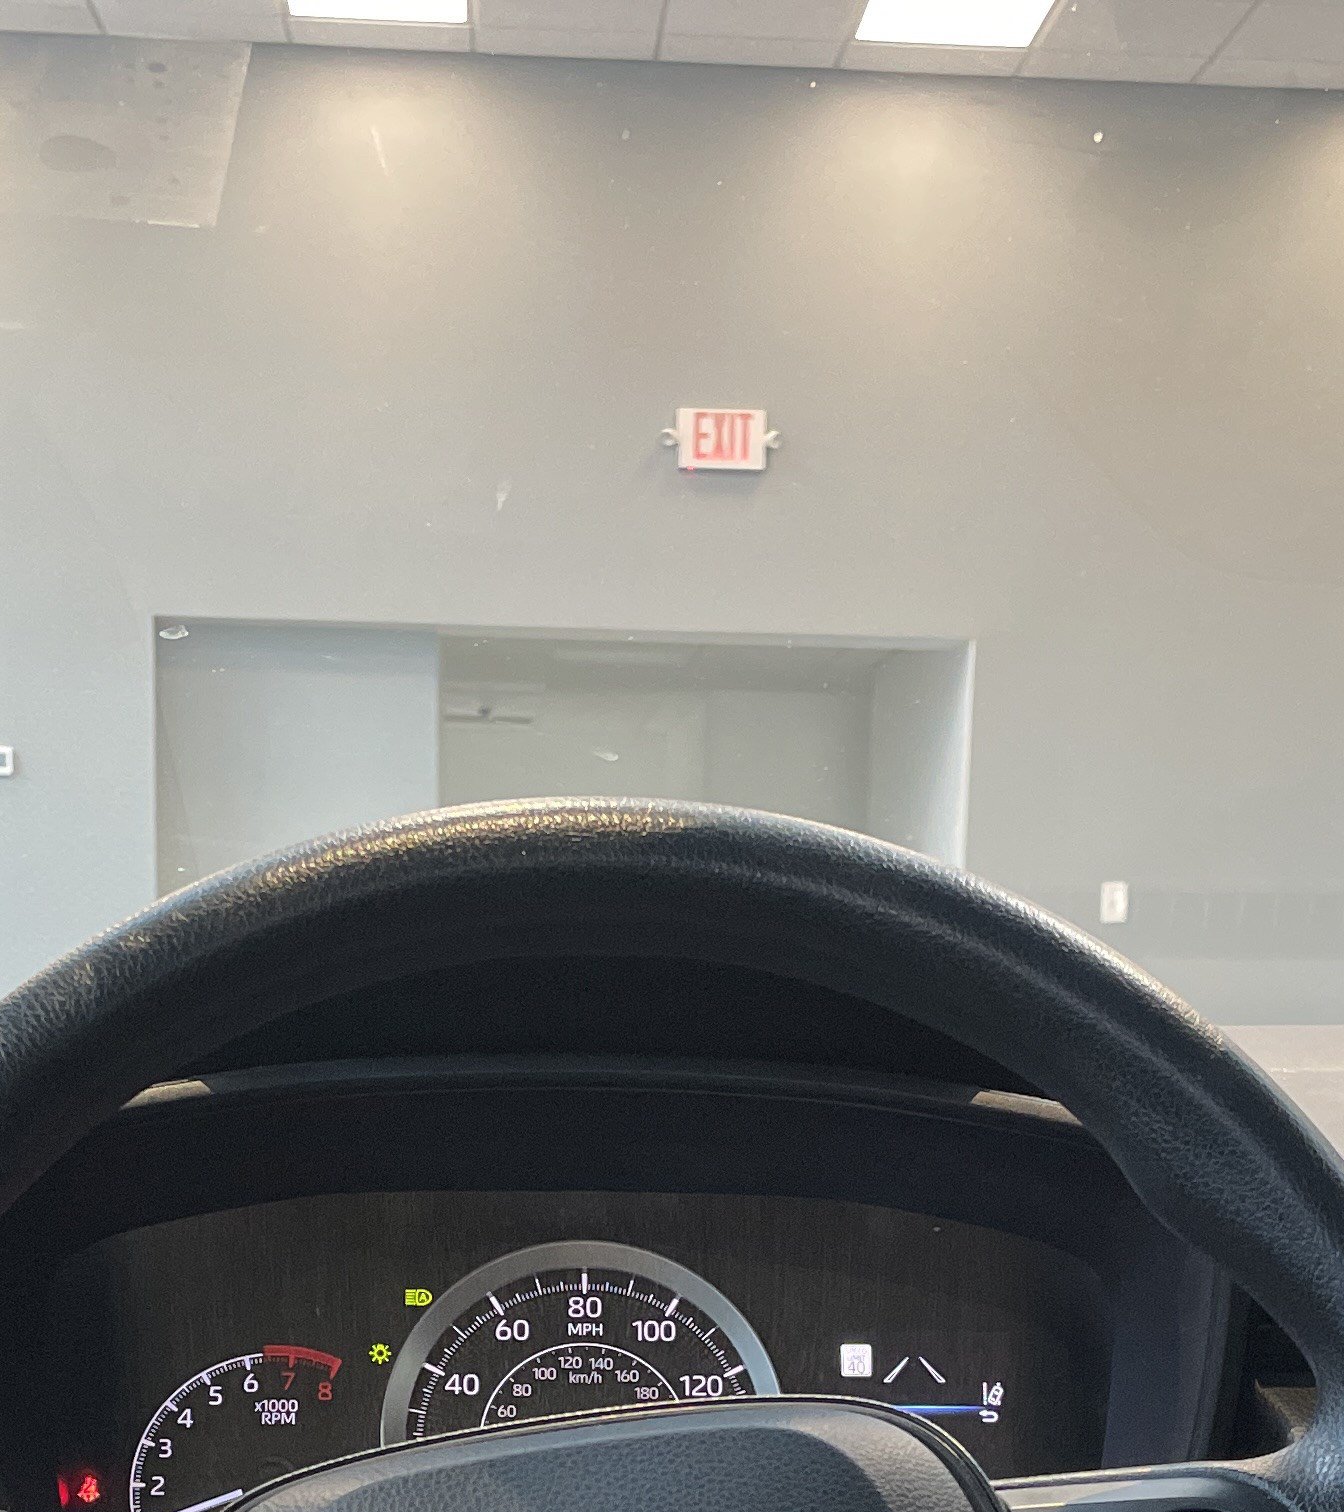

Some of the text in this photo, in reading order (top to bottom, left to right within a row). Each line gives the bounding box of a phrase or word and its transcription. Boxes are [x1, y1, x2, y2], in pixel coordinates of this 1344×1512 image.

[693, 412, 752, 460] EXIT
[567, 1296, 602, 1318] 80
[495, 1319, 529, 1341] 60
[567, 1322, 603, 1336] MPH
[632, 1320, 676, 1341] 100
[558, 1356, 582, 1369] 120
[588, 1357, 614, 1370] 140
[283, 1372, 295, 1390] 7
[532, 1367, 556, 1380] 100
[568, 1370, 602, 1384] km/h
[615, 1369, 640, 1383] 160
[243, 1373, 258, 1393] 6
[318, 1382, 332, 1400] 8
[444, 1373, 479, 1395] 40
[512, 1383, 531, 1397] 80
[679, 1375, 723, 1397] 120
[208, 1386, 222, 1405] 5
[634, 1386, 659, 1400] 180
[254, 1399, 299, 1412] x1000
[497, 1405, 516, 1418] 60
[176, 1409, 194, 1428] 4
[261, 1412, 296, 1425] RPM
[158, 1438, 173, 1458] 3
[150, 1476, 165, 1496] 2
